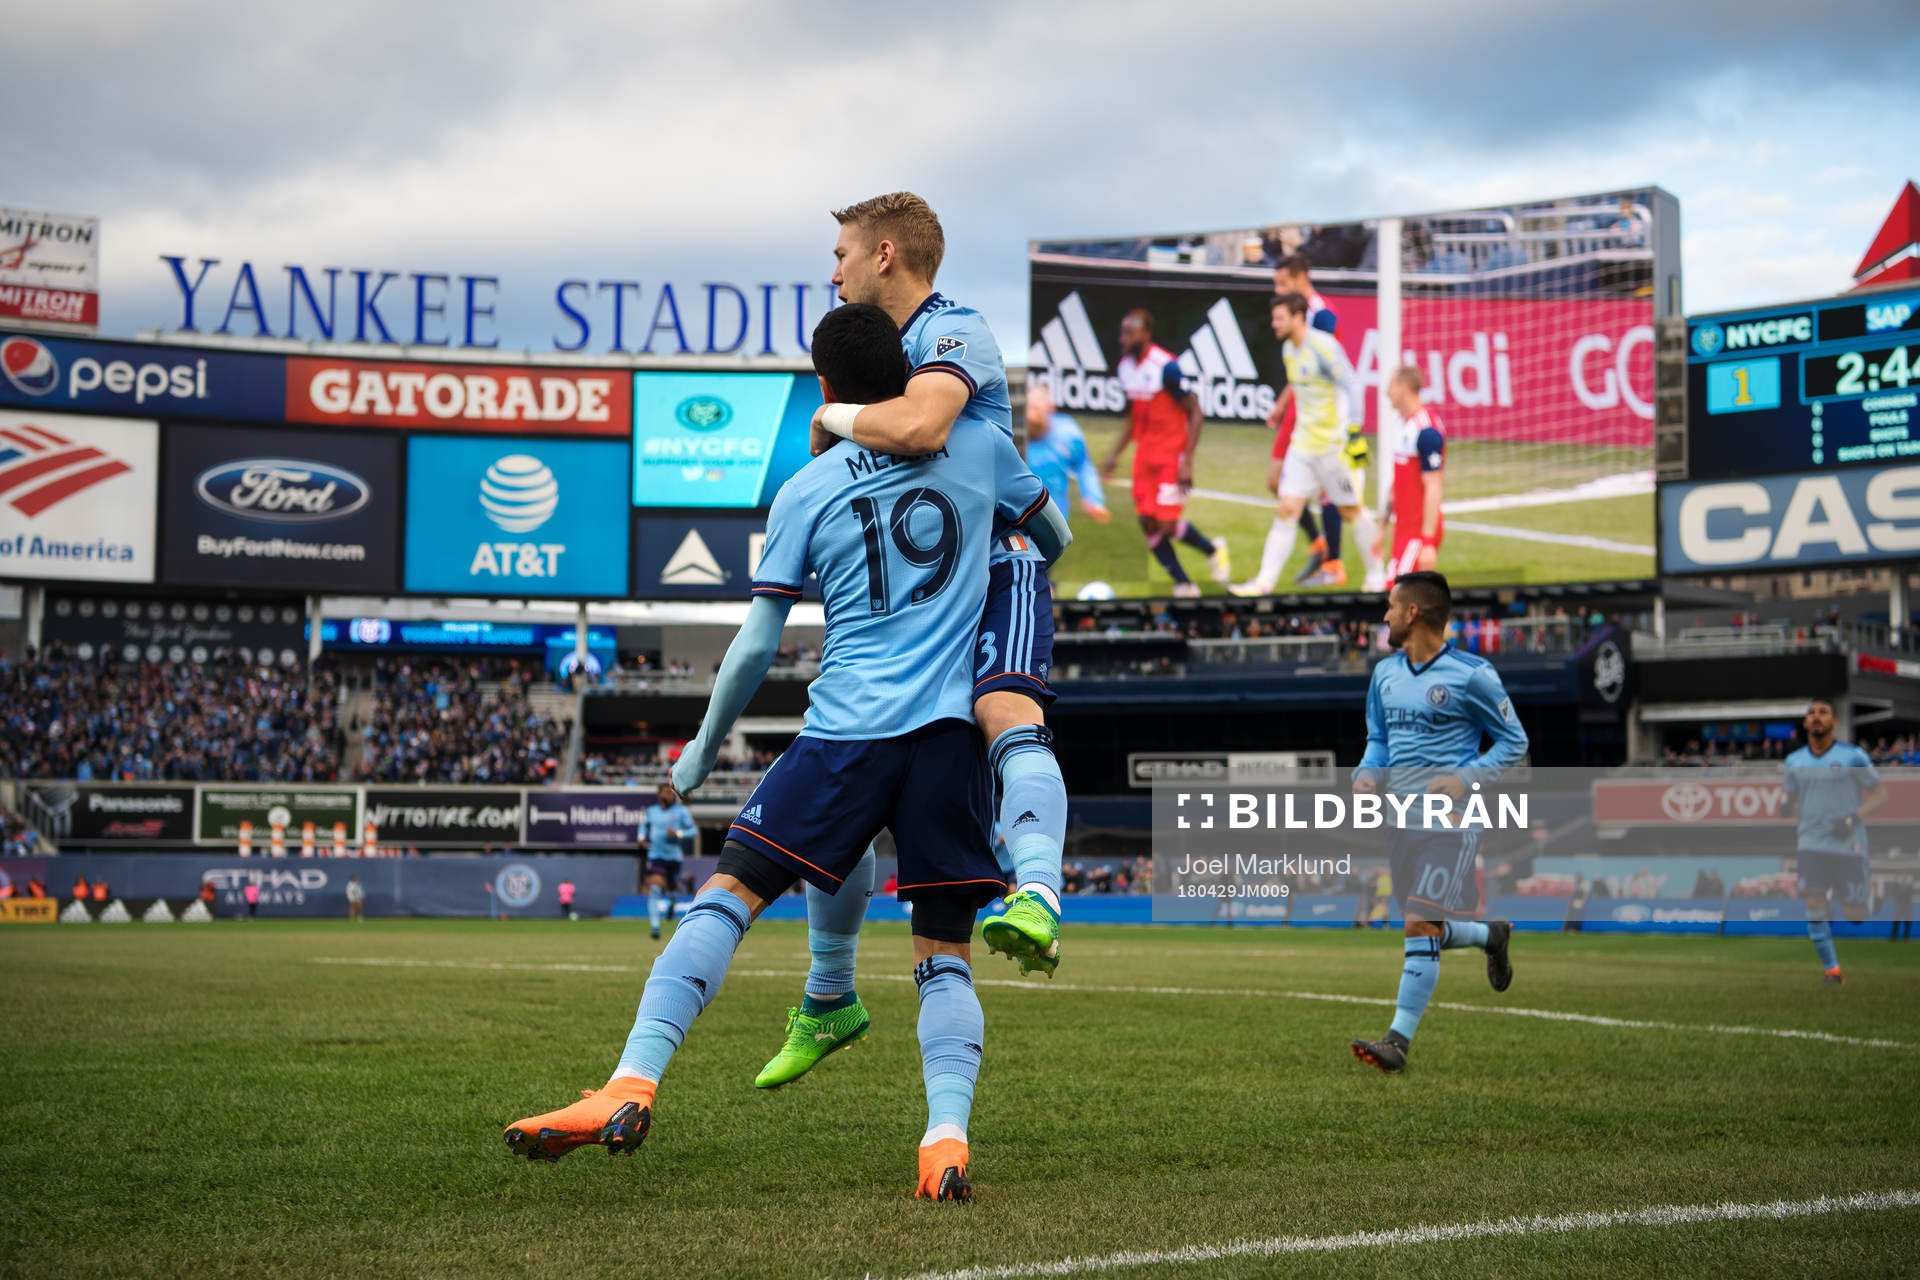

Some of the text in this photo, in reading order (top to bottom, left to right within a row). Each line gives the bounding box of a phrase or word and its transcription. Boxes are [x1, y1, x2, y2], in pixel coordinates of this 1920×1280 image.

[159, 255, 840, 357] YANKEE STADIU
[1866, 304, 1911, 331] SAP
[939, 338, 956, 347] MLS
[1726, 316, 1812, 349] NYCFC
[69, 358, 209, 404] pepsi
[1734, 367, 1753, 406] 1
[1836, 345, 1920, 396] 2:4
[309, 368, 610, 422] GATORADE
[231, 469, 338, 513] Ford
[0, 534, 134, 562] of America
[197, 535, 366, 560] BuyFordNow.com
[470, 542, 565, 577] AT&T
[850, 486, 964, 617] 19
[976, 631, 998, 679] 3
[89, 793, 183, 813] Panasonic
[1715, 787, 1784, 817] TOY
[202, 869, 328, 889] ETIHAD
[1416, 864, 1450, 900] 10
[224, 891, 305, 905] AIWAYS
